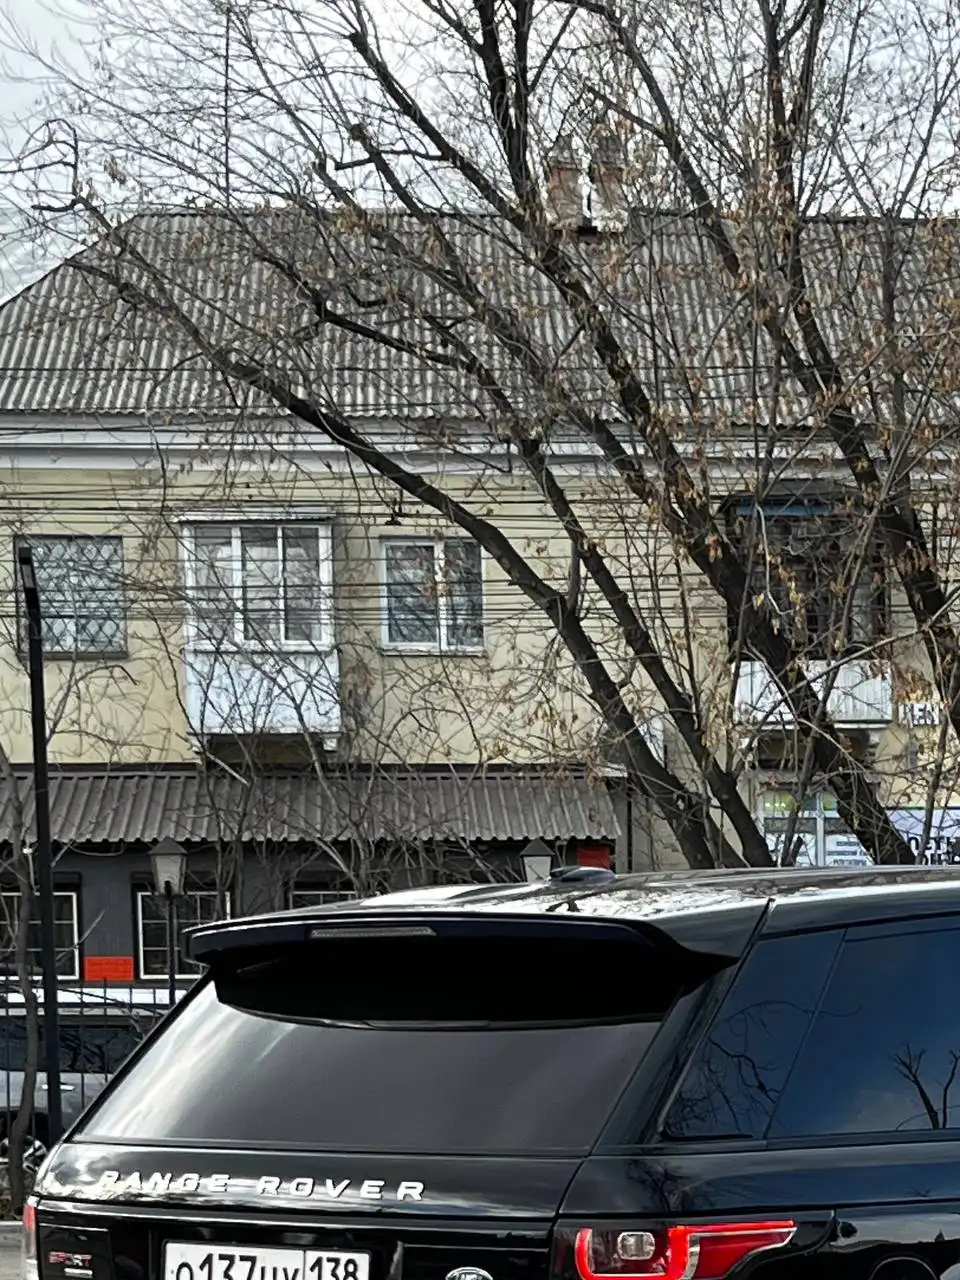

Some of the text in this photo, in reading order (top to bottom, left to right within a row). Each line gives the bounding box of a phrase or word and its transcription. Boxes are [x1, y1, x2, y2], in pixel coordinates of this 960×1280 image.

[898, 702, 960, 727] ЦЕН
[99, 1170, 425, 1201] RANGE ROVER
